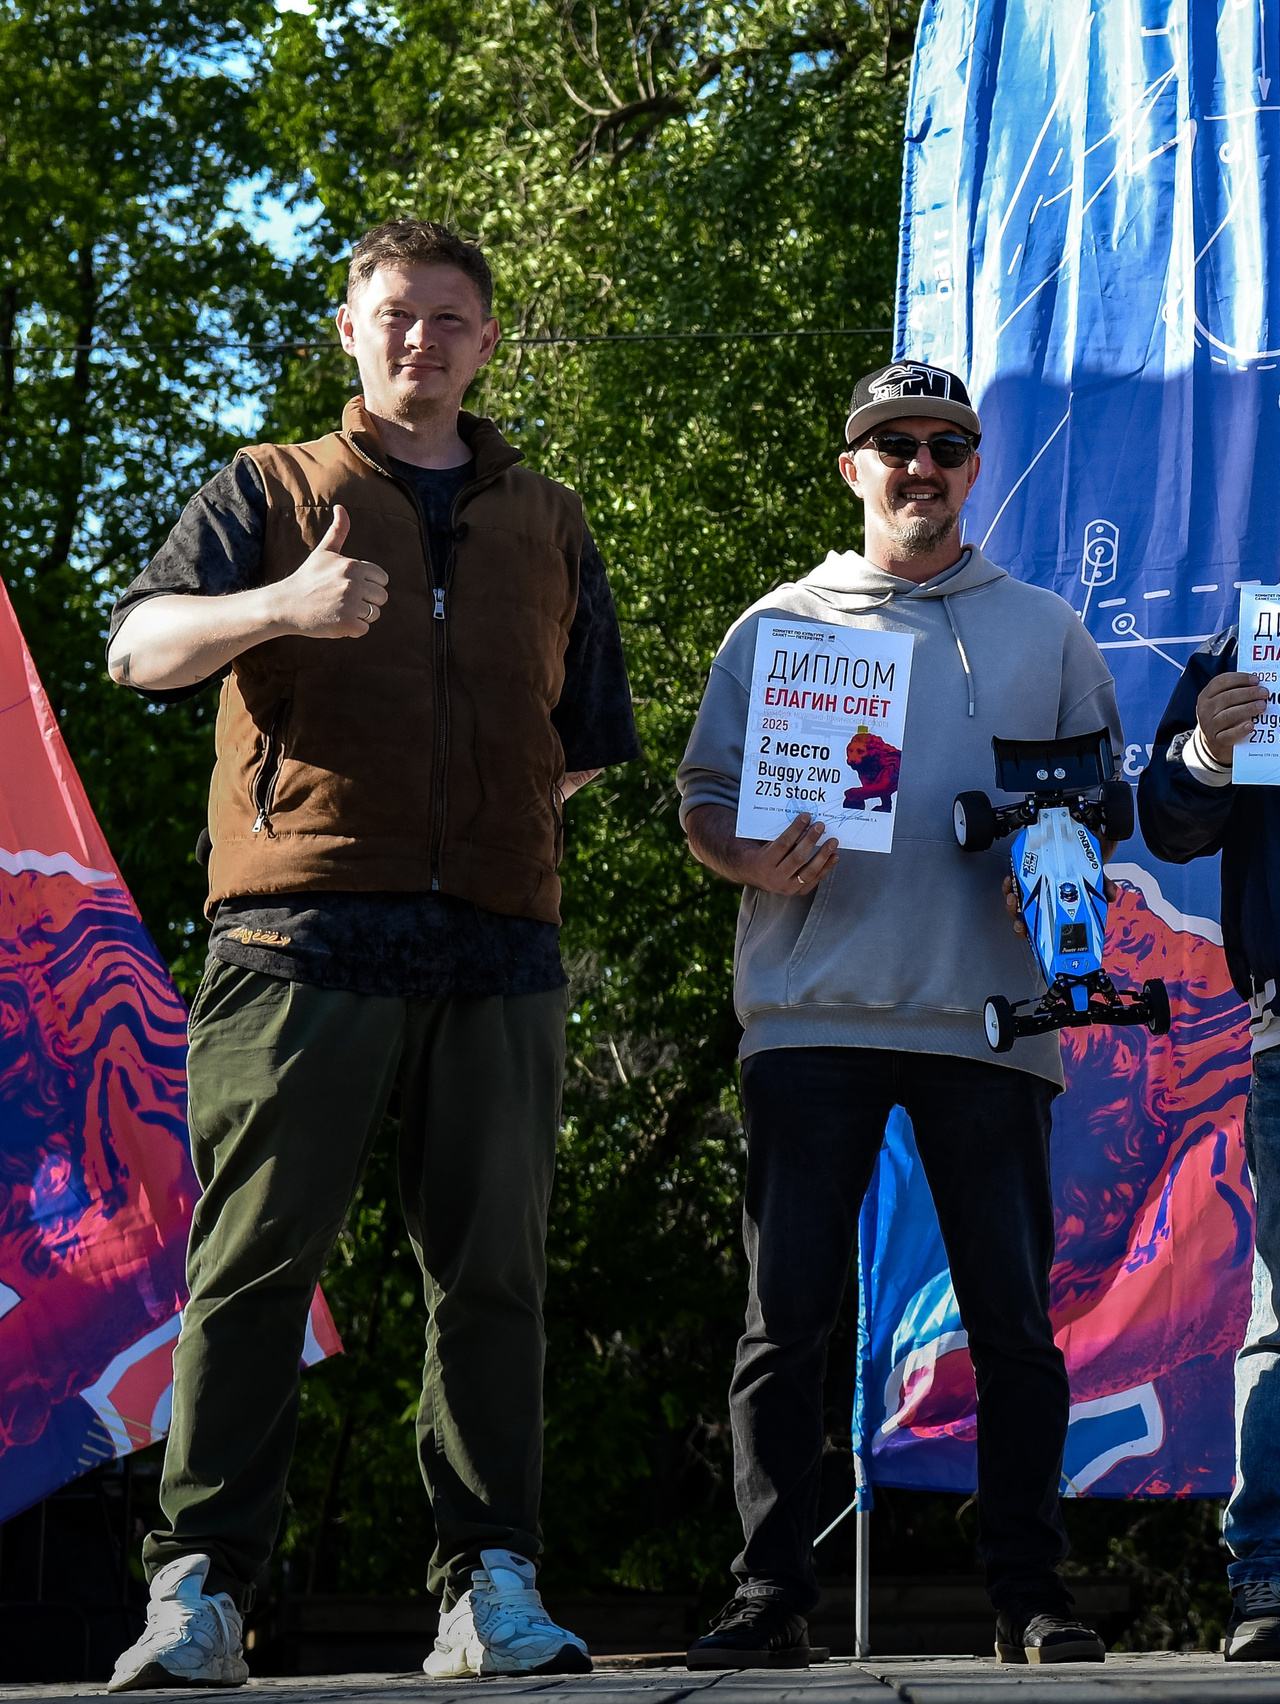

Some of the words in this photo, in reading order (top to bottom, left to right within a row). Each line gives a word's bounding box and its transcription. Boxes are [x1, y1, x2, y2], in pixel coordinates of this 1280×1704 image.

[768, 650, 896, 692] ДИПЛОМ
[765, 687, 837, 712] ЕЛАГИН
[844, 693, 891, 718] СЛЁТ
[762, 717, 789, 731] 2025
[760, 736, 770, 753] 2
[776, 743, 830, 761] место
[1250, 730, 1274, 744] 27.5
[758, 761, 803, 783] Buggy
[808, 766, 841, 784] 2WD
[755, 781, 781, 797] 27.5
[786, 782, 826, 802] stock
